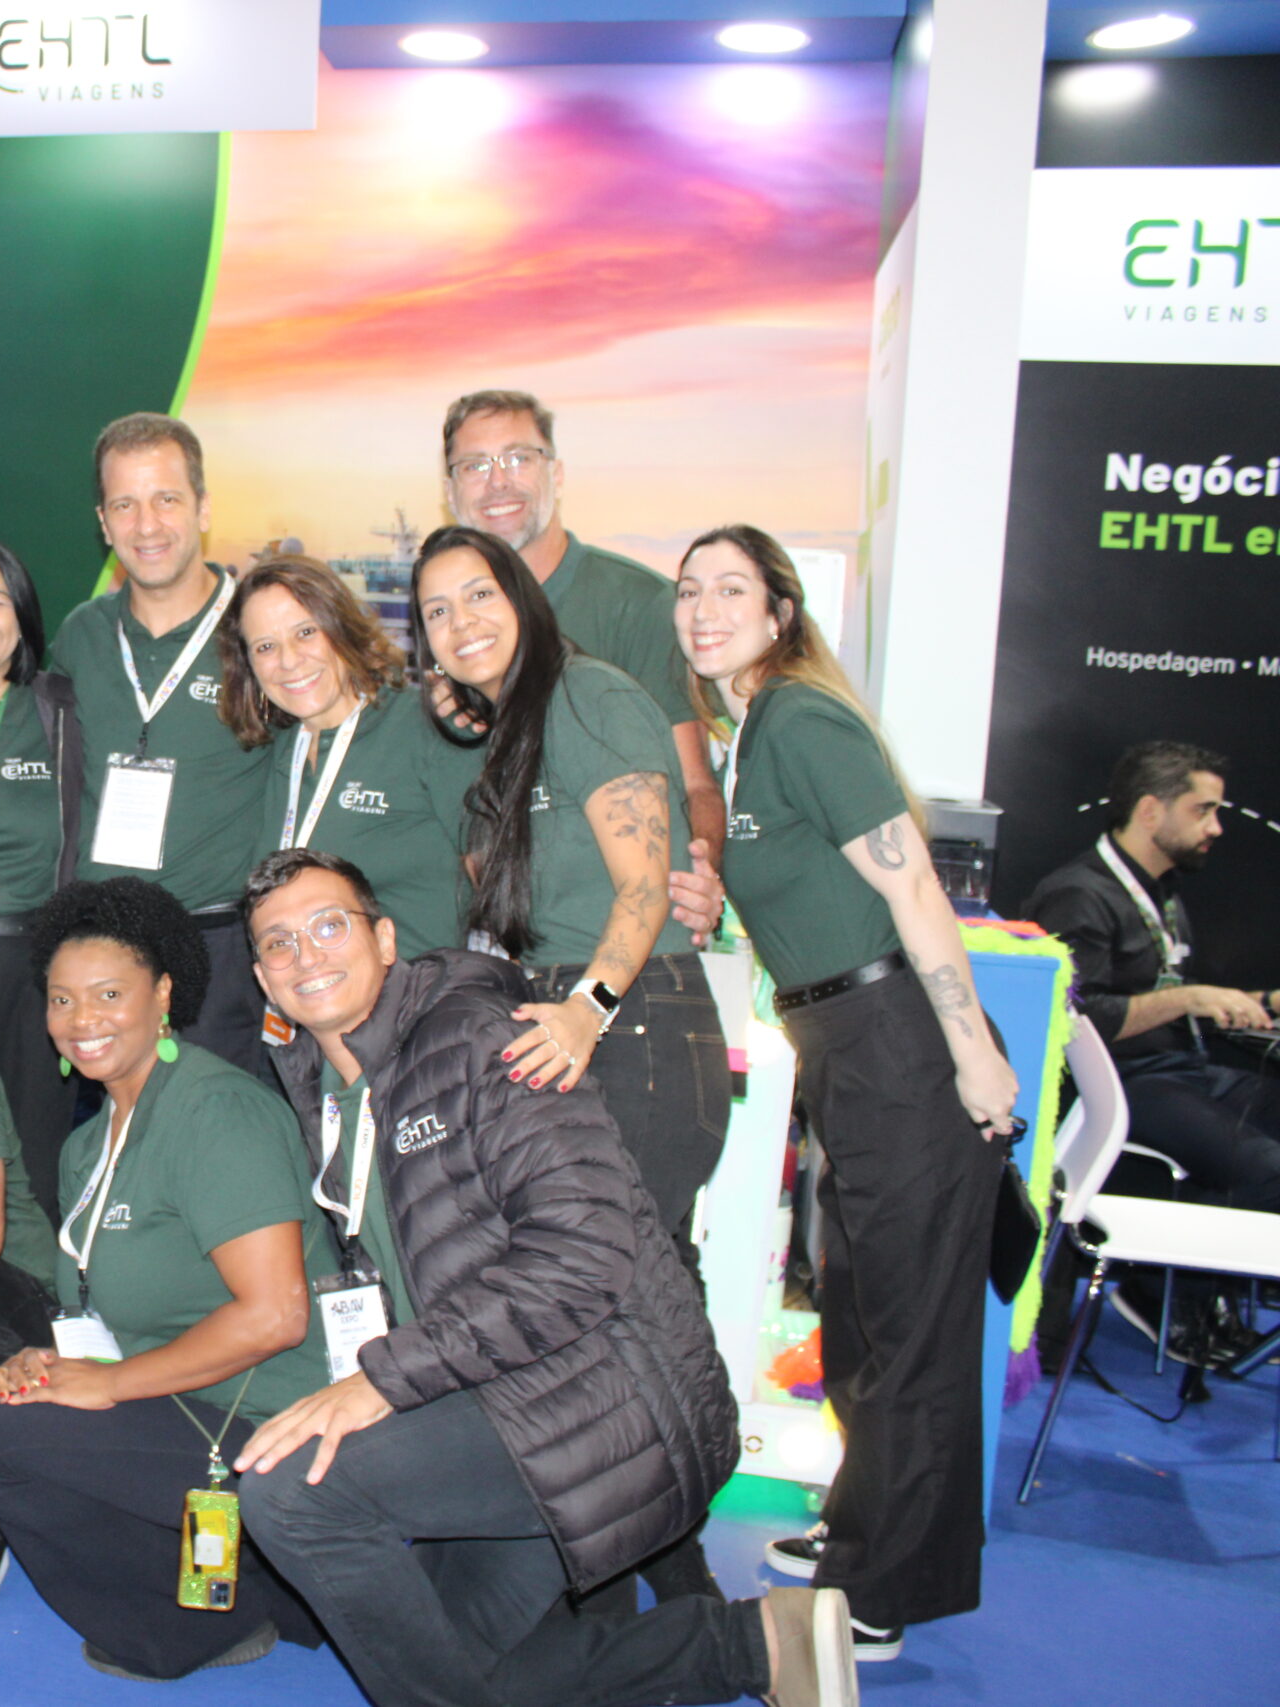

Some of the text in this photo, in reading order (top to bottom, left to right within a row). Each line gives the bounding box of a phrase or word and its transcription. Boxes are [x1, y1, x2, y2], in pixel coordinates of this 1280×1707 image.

[38, 81, 165, 102] VIAGENS
[1123, 218, 1280, 289] EH
[1123, 305, 1269, 323] VIAGENS
[1104, 452, 1280, 504] Negóci
[1099, 511, 1280, 556] EHTL e
[1086, 646, 1236, 677] Hospedagem
[190, 682, 223, 700] EH
[3, 762, 52, 776] EHTL
[341, 789, 389, 808] EHTL
[400, 1113, 447, 1149] EHTL
